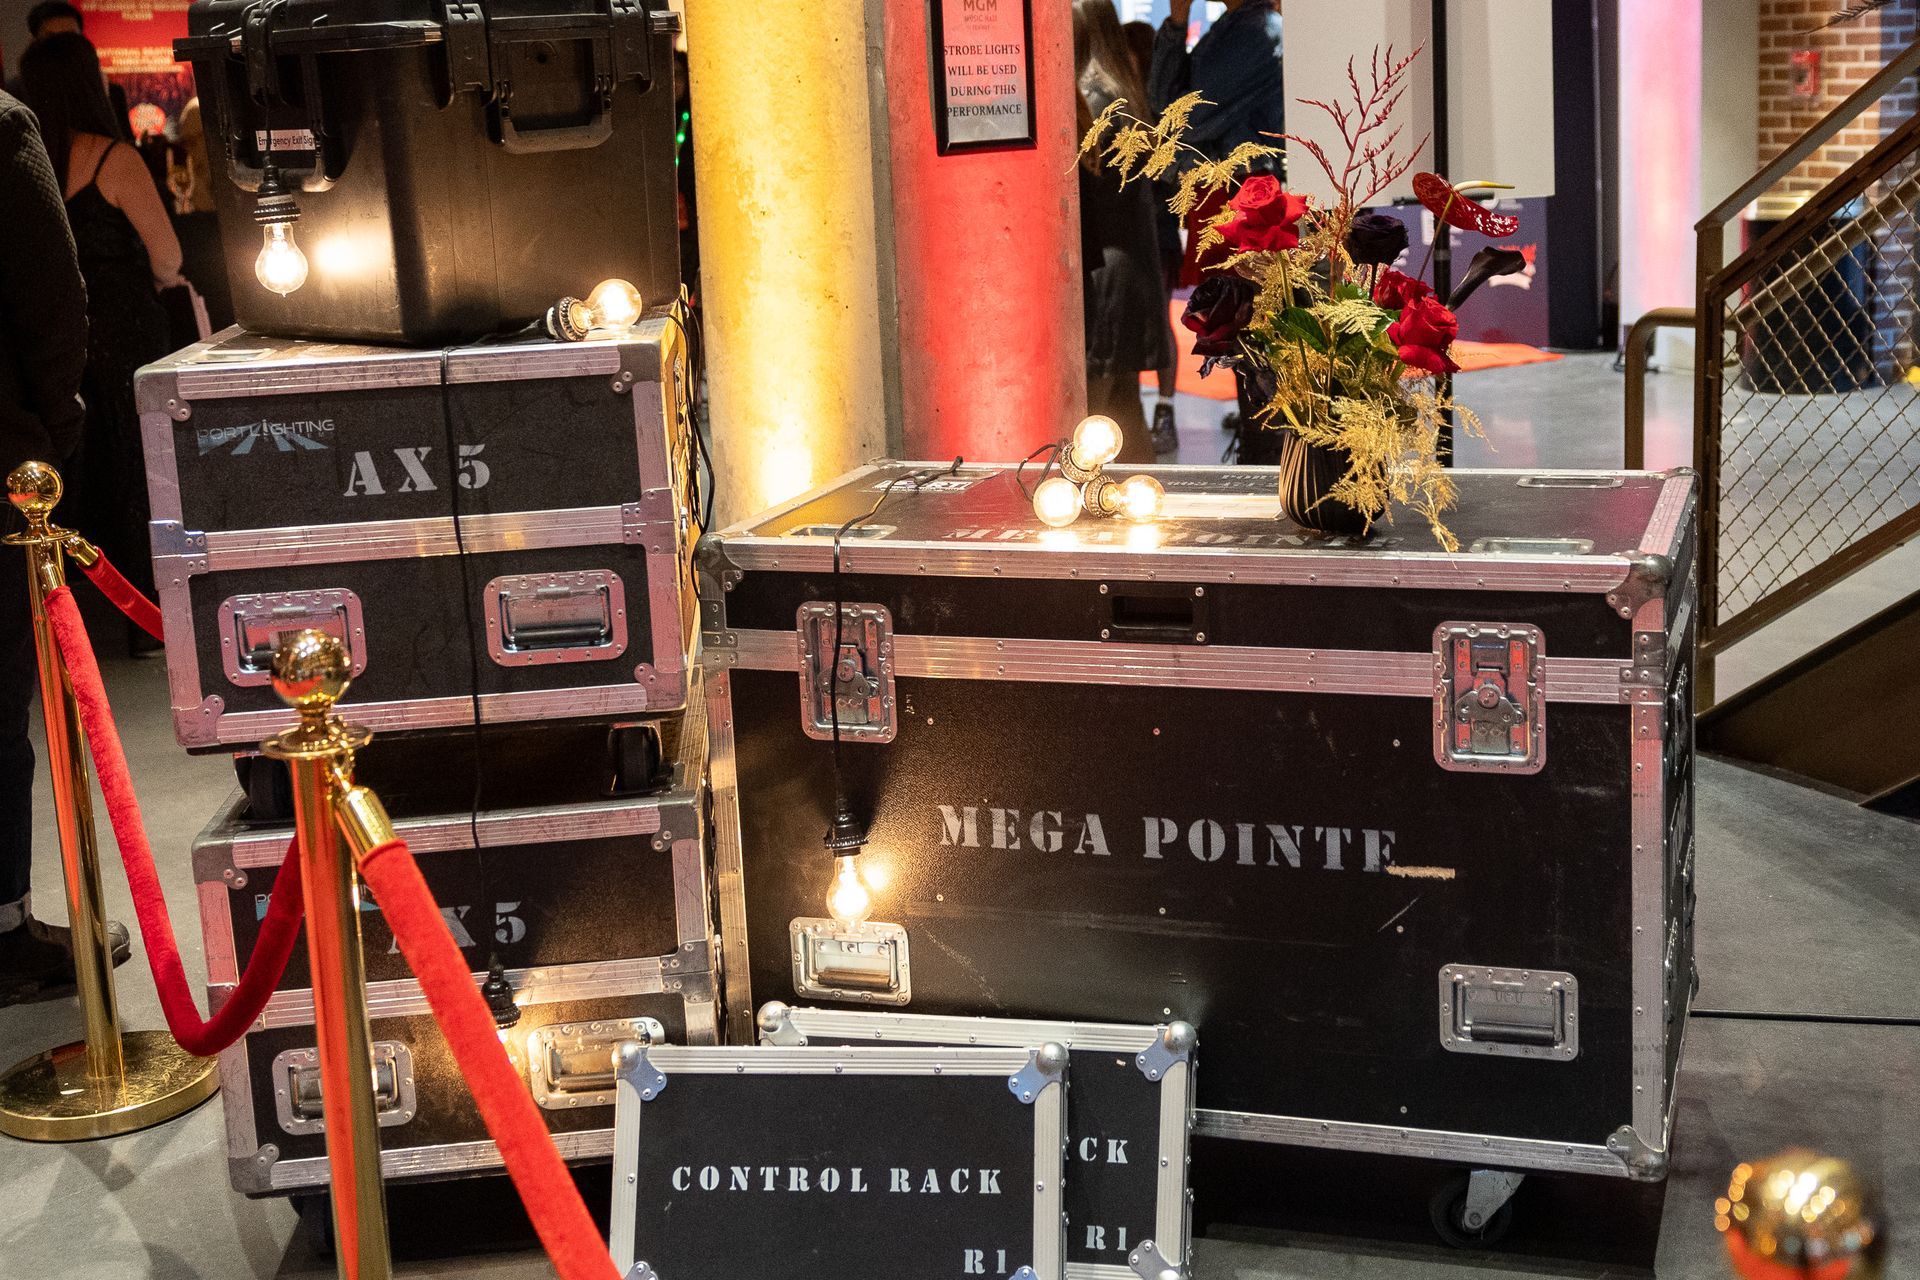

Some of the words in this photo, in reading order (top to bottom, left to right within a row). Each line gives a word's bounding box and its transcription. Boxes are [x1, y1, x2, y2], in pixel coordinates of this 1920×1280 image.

[963, 0, 997, 11] MGM
[944, 45, 983, 56] STROBE
[985, 44, 1020, 55] LIGHTS
[947, 65, 974, 77] WILL
[976, 66, 989, 75] BE
[991, 64, 1017, 75] USED
[950, 86, 991, 97] DURING
[993, 84, 1017, 95] THIS
[948, 104, 1022, 118] PERFORMANCE
[303, 135, 314, 146] Sig
[457, 443, 491, 489] 5
[937, 804, 1111, 856] MEGA
[1142, 816, 1396, 873] POINTE
[494, 900, 527, 944] 5
[672, 1165, 868, 1194] CONTROL
[889, 1167, 1001, 1195] RACK
